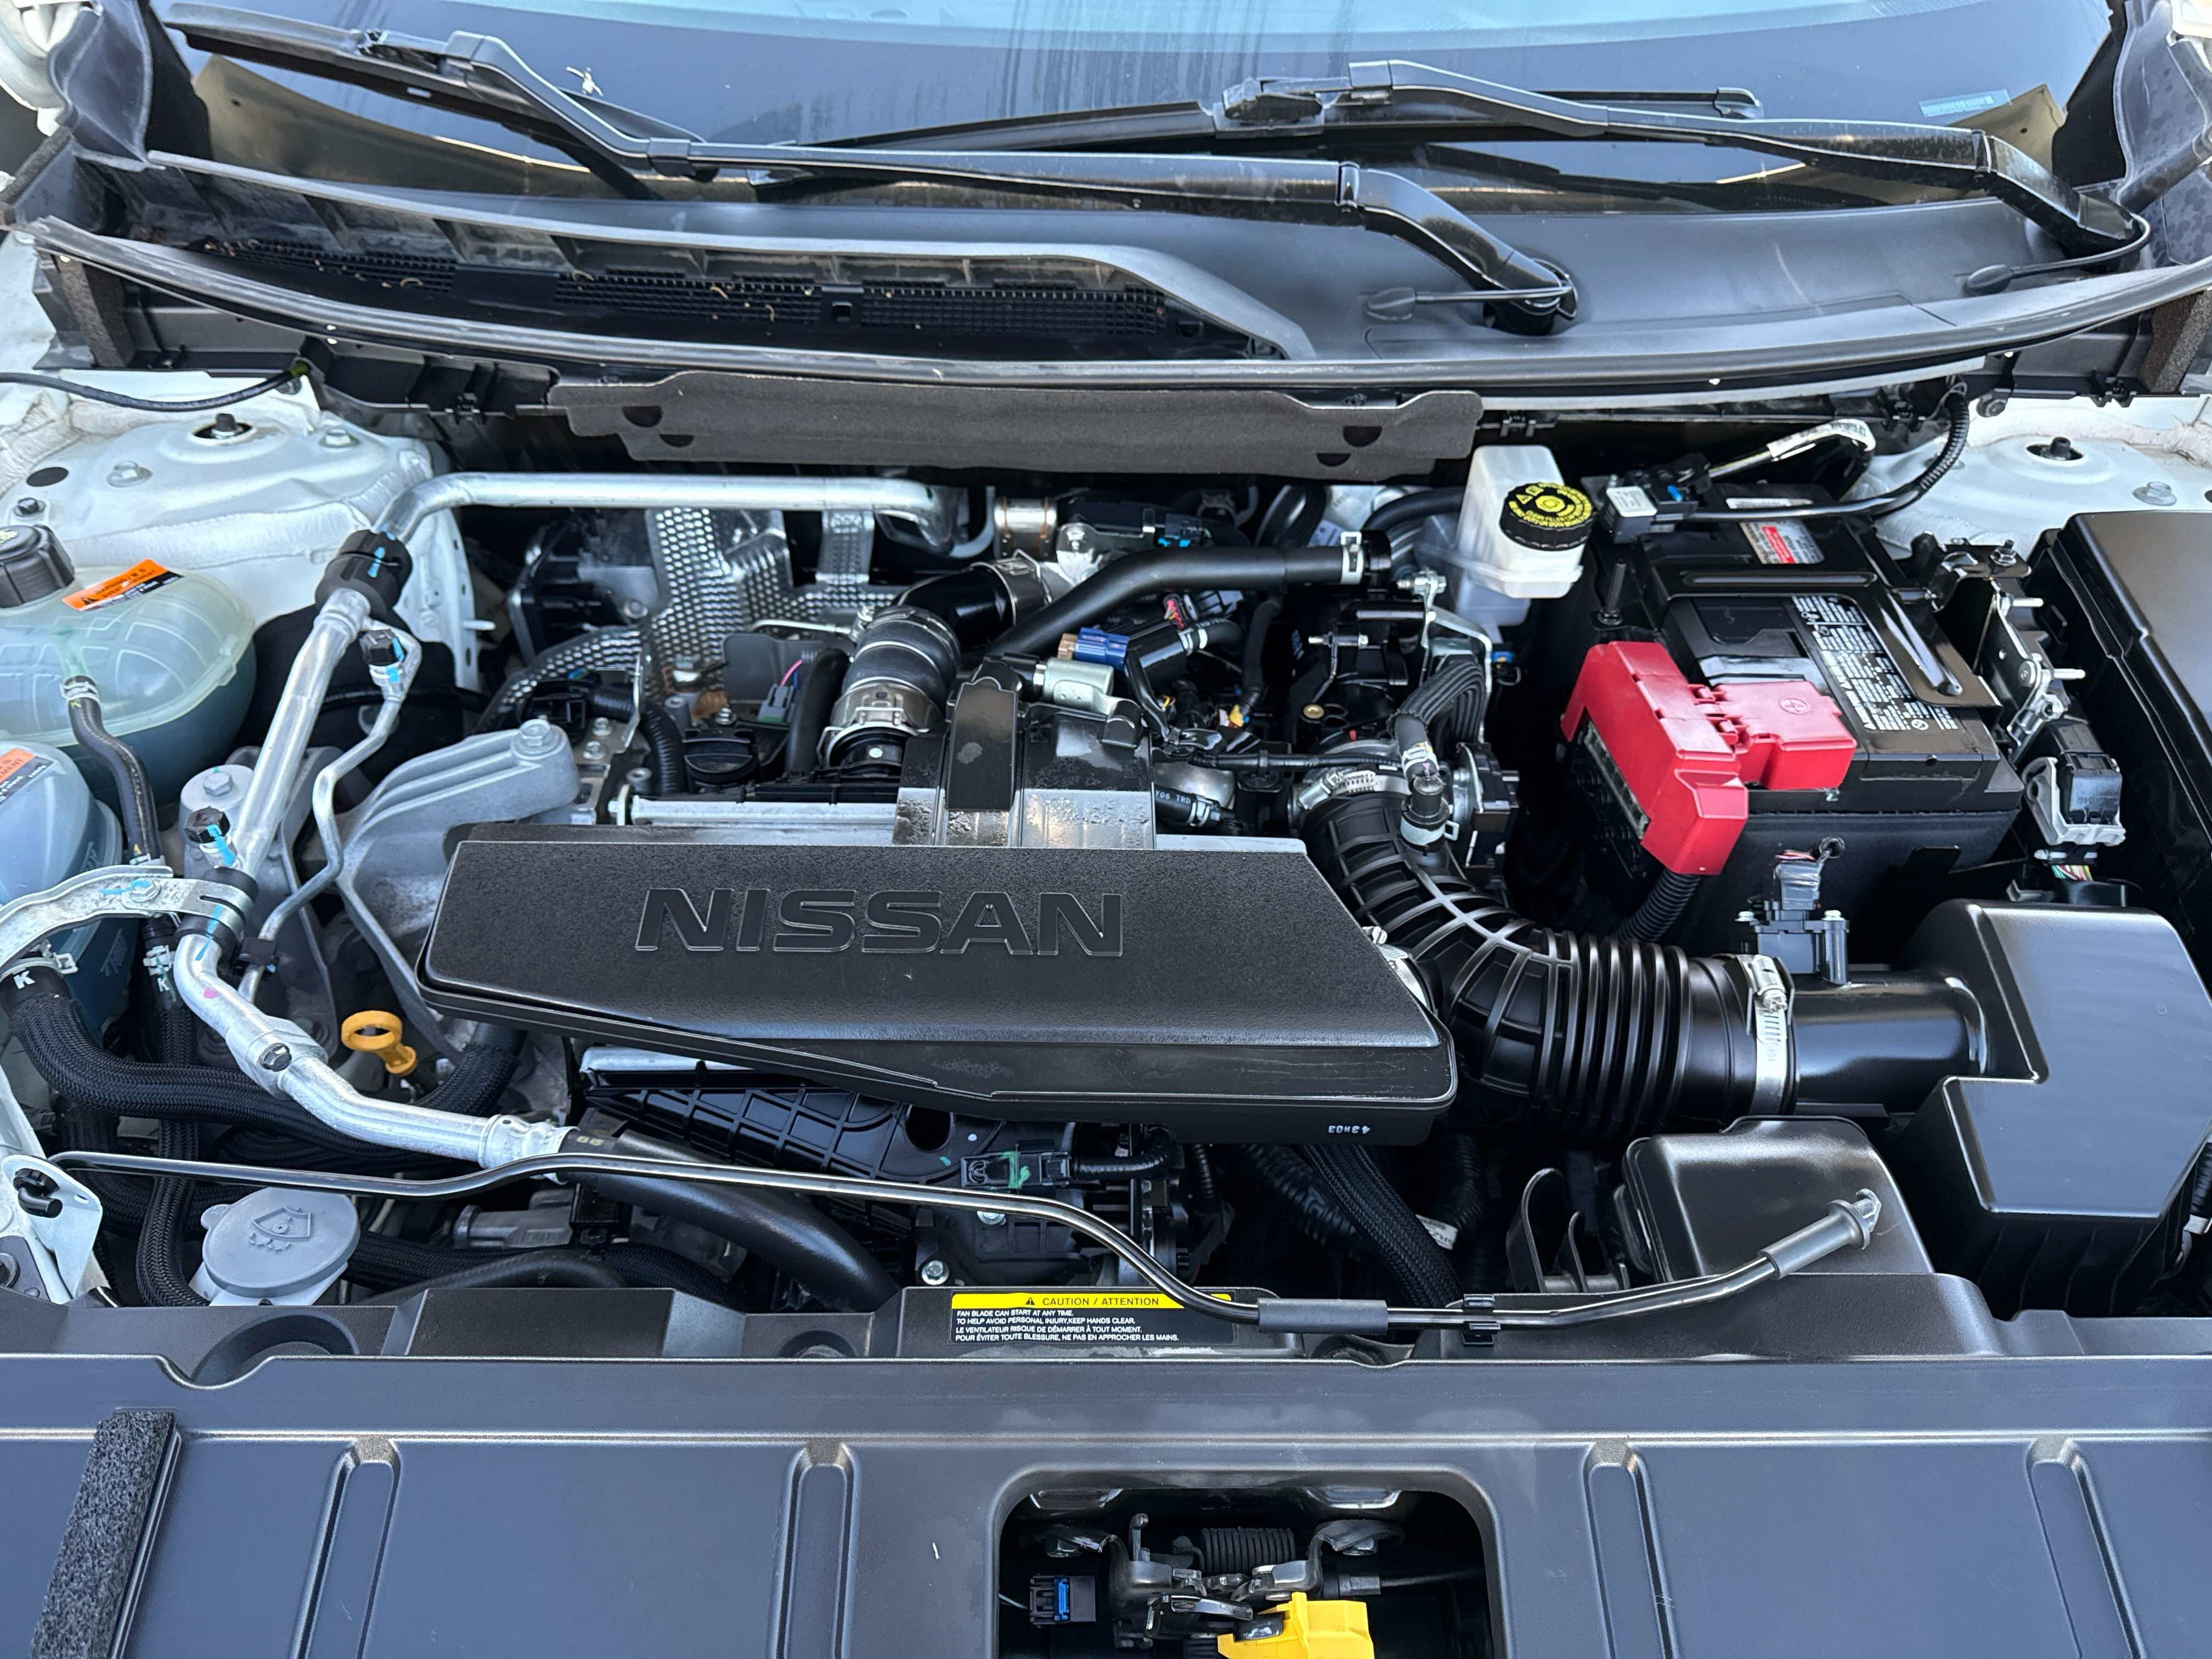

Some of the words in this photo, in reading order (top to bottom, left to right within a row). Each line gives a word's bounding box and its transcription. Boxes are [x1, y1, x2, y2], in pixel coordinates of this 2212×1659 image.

[1176, 794, 1191, 804] TRD
[635, 888, 1124, 957] NISSAN
[13, 970, 36, 990] K
